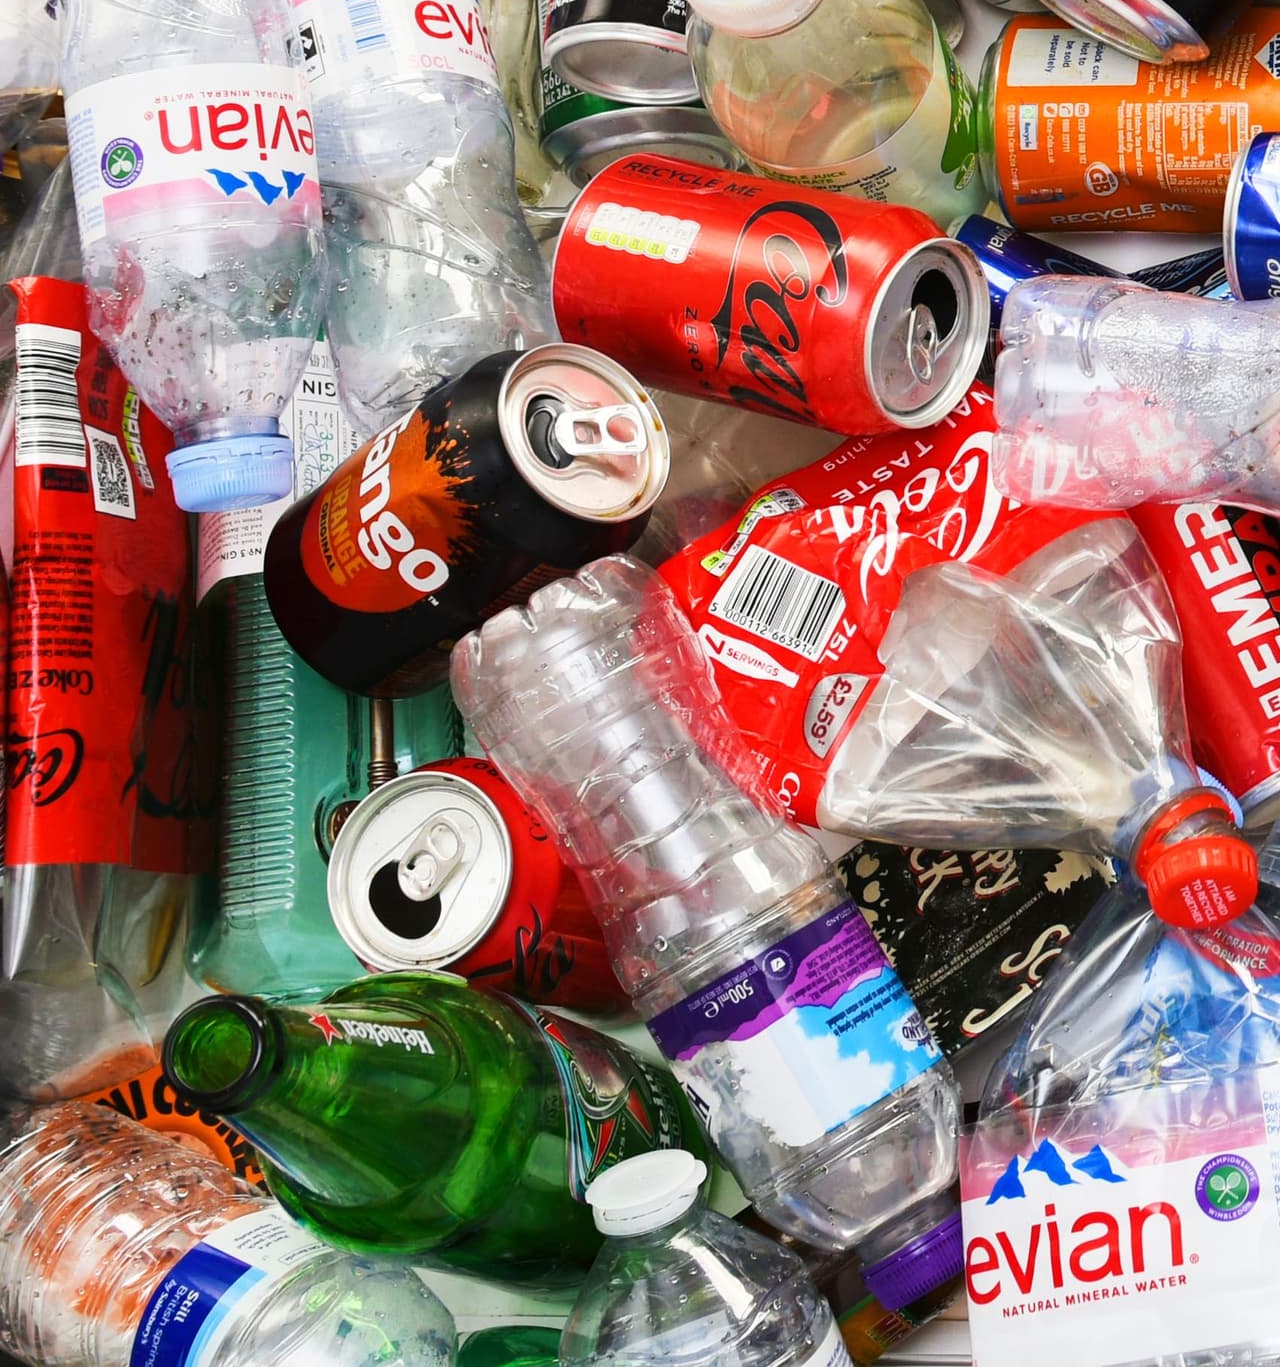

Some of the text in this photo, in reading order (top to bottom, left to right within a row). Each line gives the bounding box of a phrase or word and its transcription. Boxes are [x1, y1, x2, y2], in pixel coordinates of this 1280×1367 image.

[829, 440, 935, 507] TASTE
[725, 649, 781, 677] SERVINGS
[965, 1200, 1188, 1307] evian
[1001, 1273, 1188, 1317] NATURAL MINERAL WATER
